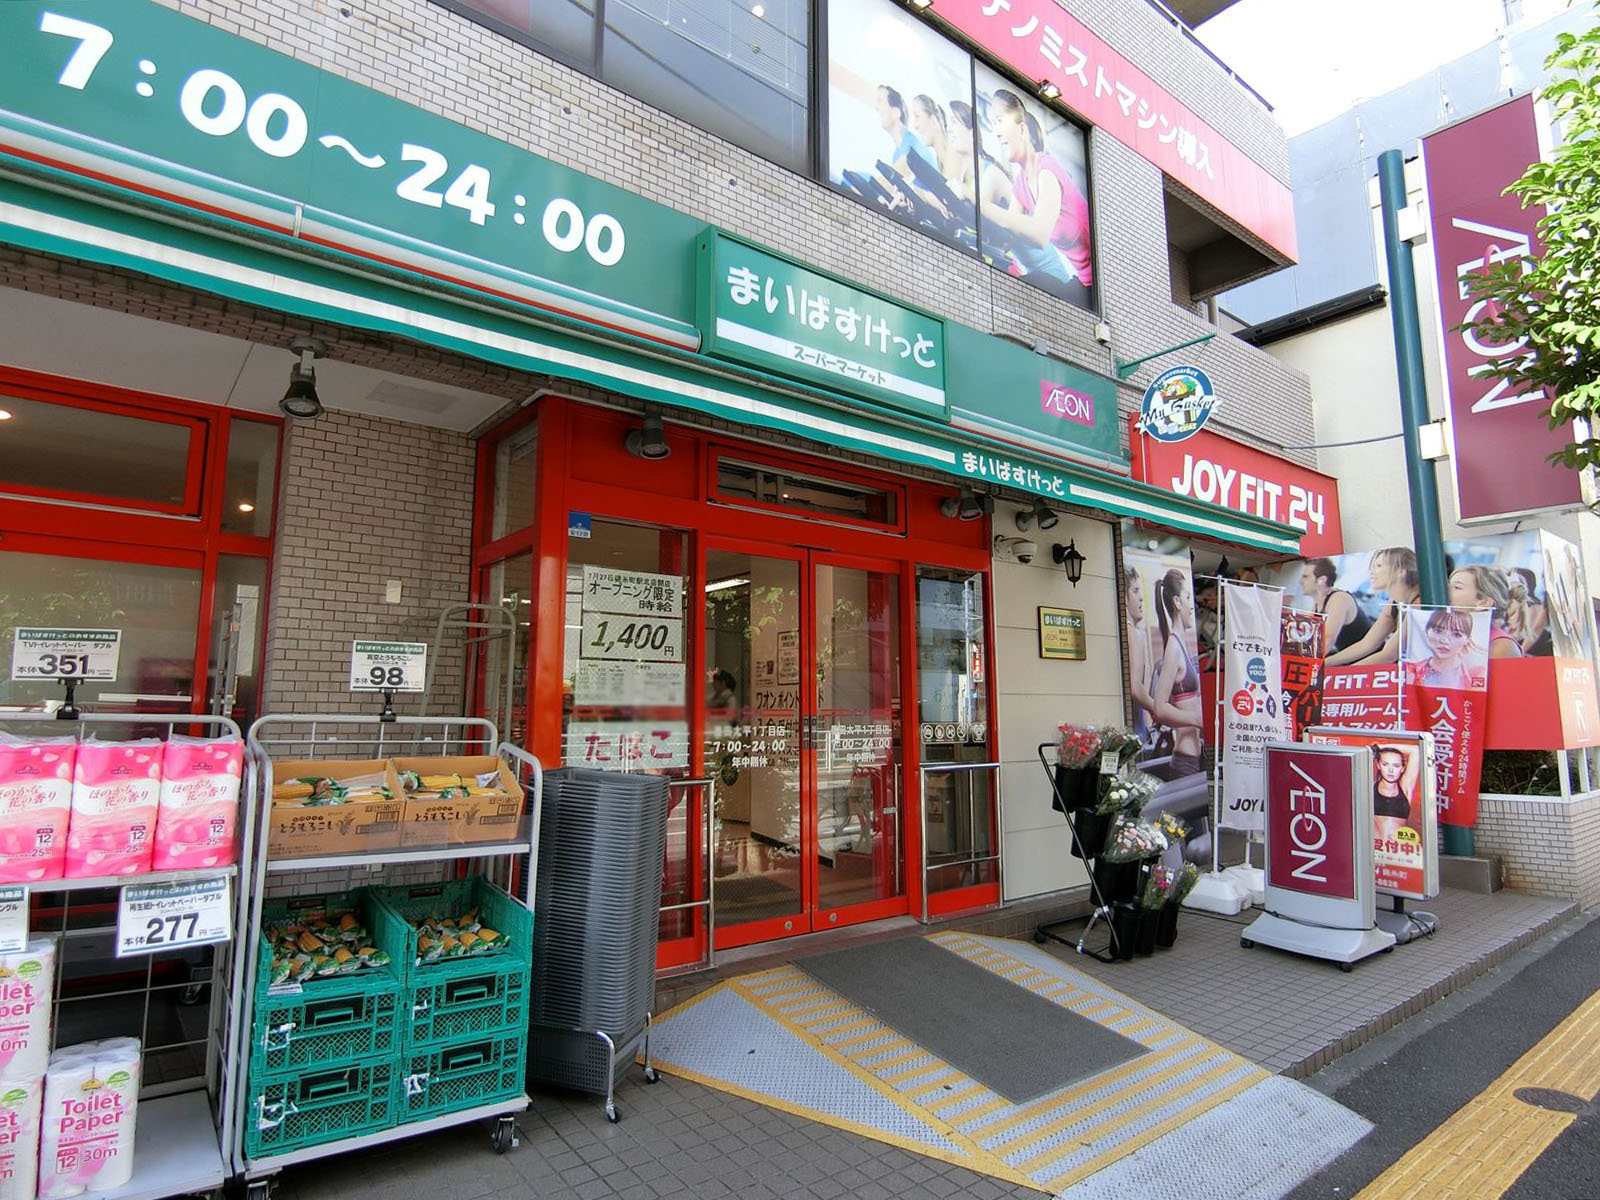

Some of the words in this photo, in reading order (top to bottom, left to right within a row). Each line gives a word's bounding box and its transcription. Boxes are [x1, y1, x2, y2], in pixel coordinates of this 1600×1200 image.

[726, 265, 938, 369] まいばすけっと
[793, 344, 887, 385] スーパーマーケット
[1152, 367, 1199, 389] Supermarket
[1140, 407, 1166, 428] My
[961, 451, 1067, 498] まいばすけっと
[1288, 484, 1325, 535] 24
[589, 581, 676, 603] オープニング限定
[638, 599, 673, 613] 時給
[369, 666, 405, 686] 98
[584, 731, 674, 762] たばこ
[37, 834, 52, 844] 12
[132, 830, 145, 840] 12
[211, 824, 224, 833] 12
[146, 912, 200, 945] 277
[62, 1092, 122, 1117] Toilet
[59, 1111, 124, 1134] Paper
[59, 1155, 77, 1169] 12
